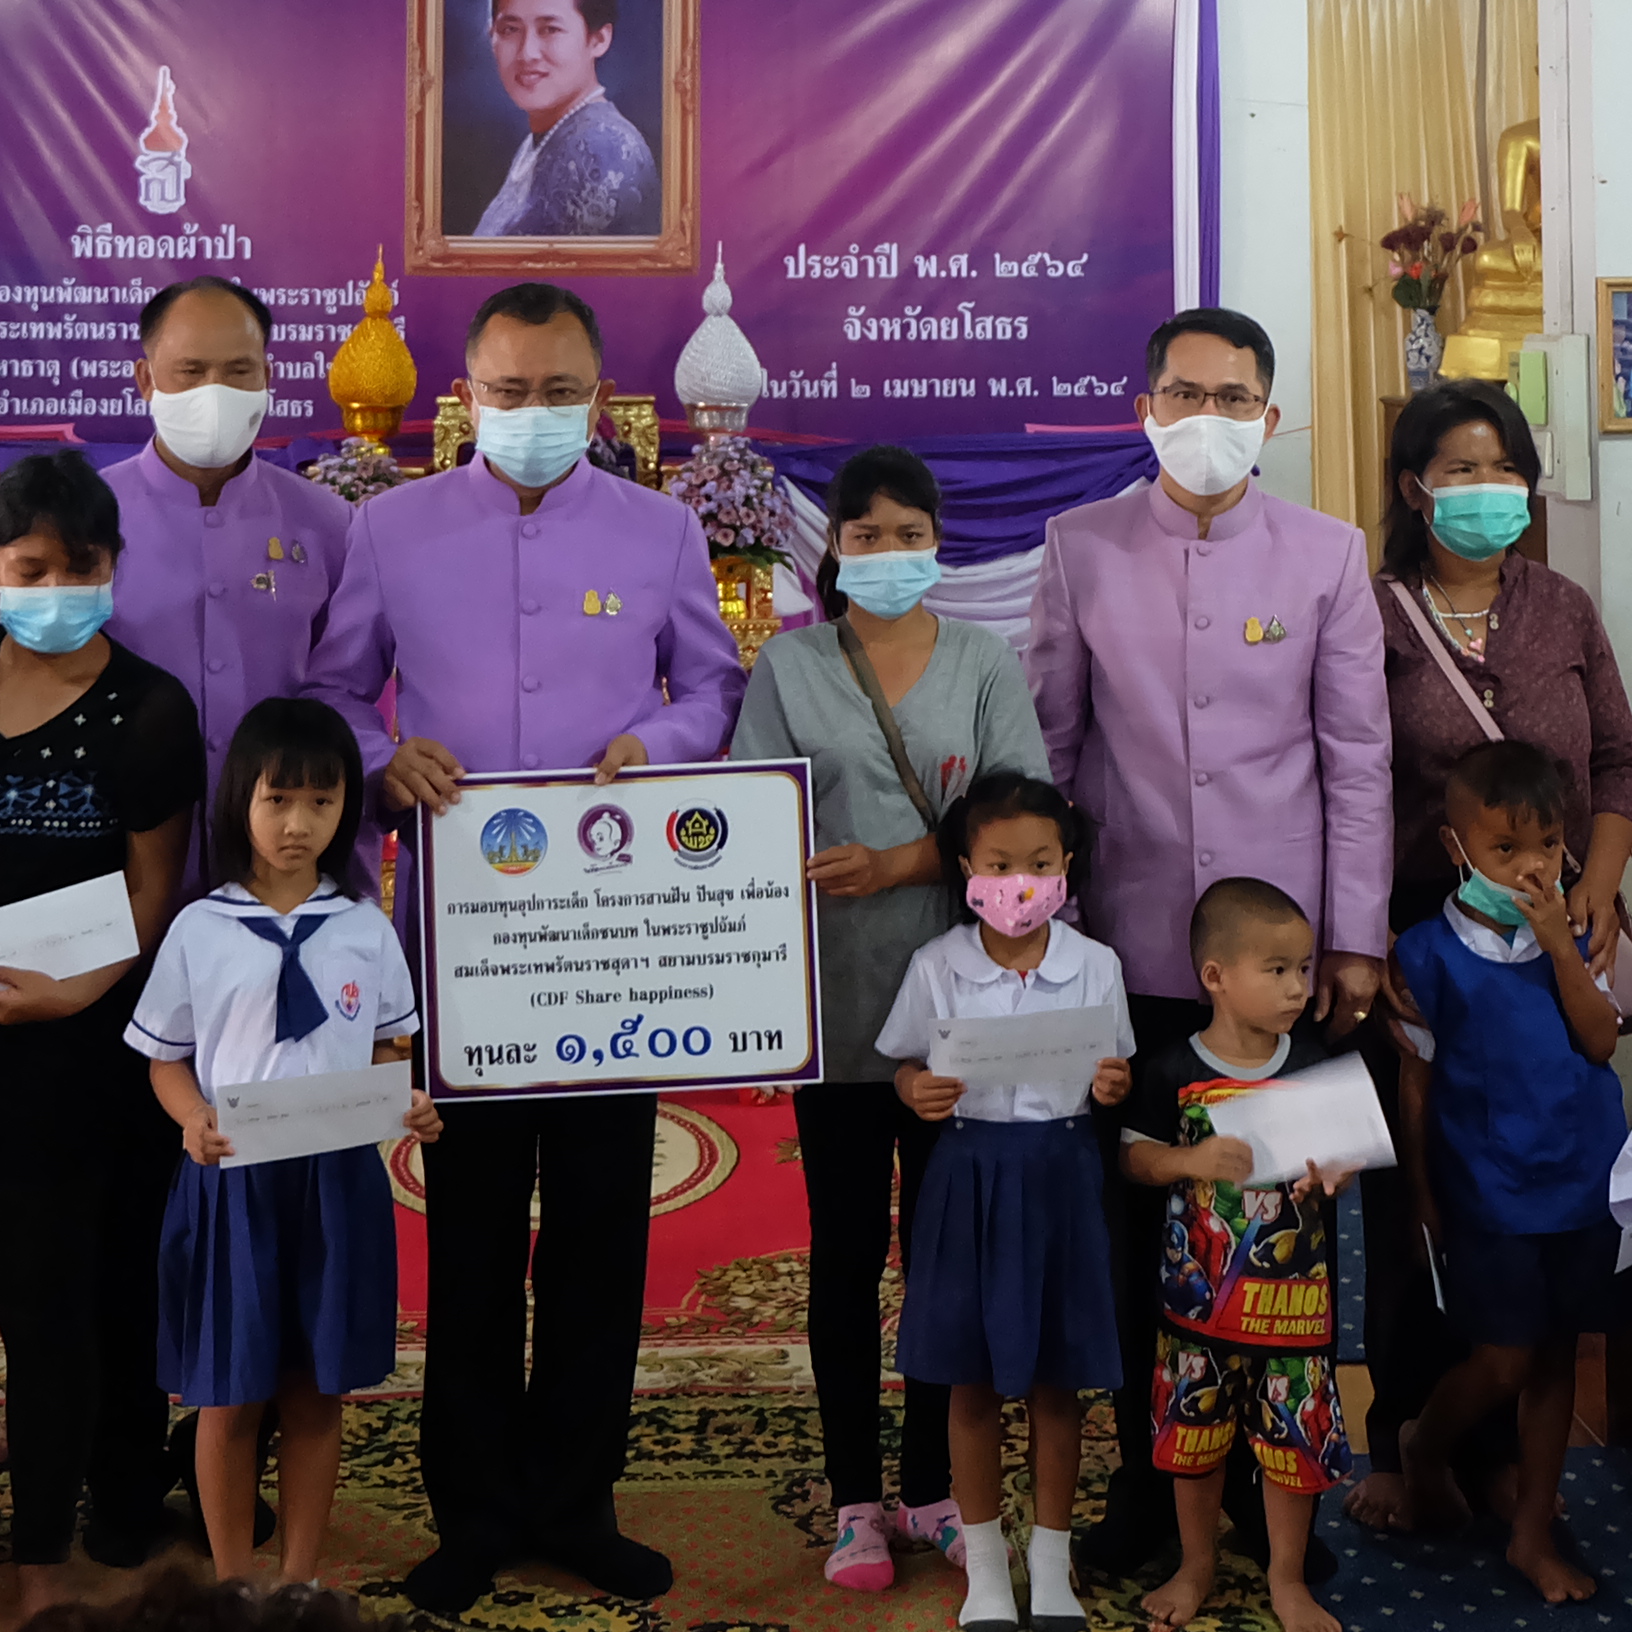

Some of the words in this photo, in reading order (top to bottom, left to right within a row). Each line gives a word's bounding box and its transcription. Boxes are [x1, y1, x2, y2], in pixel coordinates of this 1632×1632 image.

[71, 222, 252, 260] พิธีทอดผ้าป่า
[783, 242, 899, 279] ประจำปี
[914, 252, 978, 279] พ.ศ.
[994, 251, 1089, 278] ๒๕๖๔
[843, 301, 1029, 341] จังหวัดยโสธร
[850, 378, 870, 399] ๒
[883, 377, 976, 399] เมษายน
[988, 376, 1039, 398] พ.ศ.
[1052, 375, 1128, 398] ๒๕๖๔
[593, 886, 691, 908] โครงการสานฝัน
[696, 884, 735, 907] ปันสุข
[740, 877, 790, 900] เพื่อน้อง
[493, 922, 639, 950] กองทุนพัฒนาเด็กชนบท
[643, 913, 747, 941] ในพระราชูปถัมภ์
[658, 942, 788, 969] สยามบรมราชกุมารี
[529, 991, 569, 1009] (CDF
[575, 989, 622, 1005] Share
[628, 983, 715, 1005] happiness)
[463, 1042, 538, 1077] ทุนละ
[728, 1028, 783, 1053] บาท
[1242, 1189, 1283, 1223] VS
[1241, 1281, 1329, 1317] THANOS
[1240, 1316, 1270, 1335] THE
[1272, 1319, 1326, 1335] MARVEL
[1178, 1351, 1207, 1380] VS
[1267, 1376, 1289, 1402] VS
